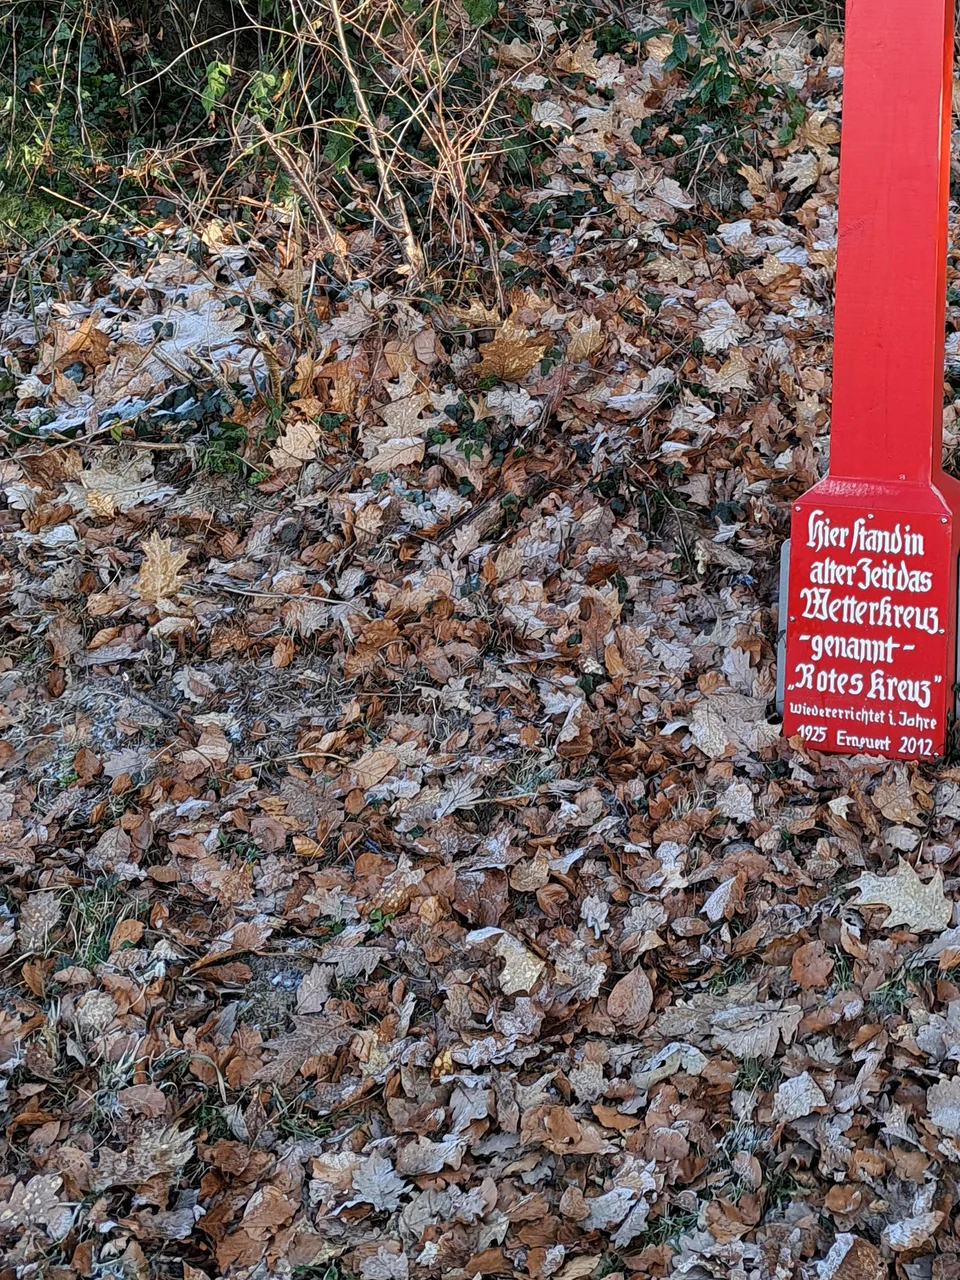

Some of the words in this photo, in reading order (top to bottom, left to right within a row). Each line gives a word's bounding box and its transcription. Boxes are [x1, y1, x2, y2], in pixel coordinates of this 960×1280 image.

[806, 510, 849, 552] Hier
[904, 525, 925, 556] in
[809, 557, 857, 586] alter
[857, 557, 897, 591] Zeit
[896, 560, 933, 593] das
[888, 709, 897, 726] i.
[898, 711, 937, 731] Jahre
[796, 724, 828, 743] 1925
[836, 729, 892, 752] Erneuert
